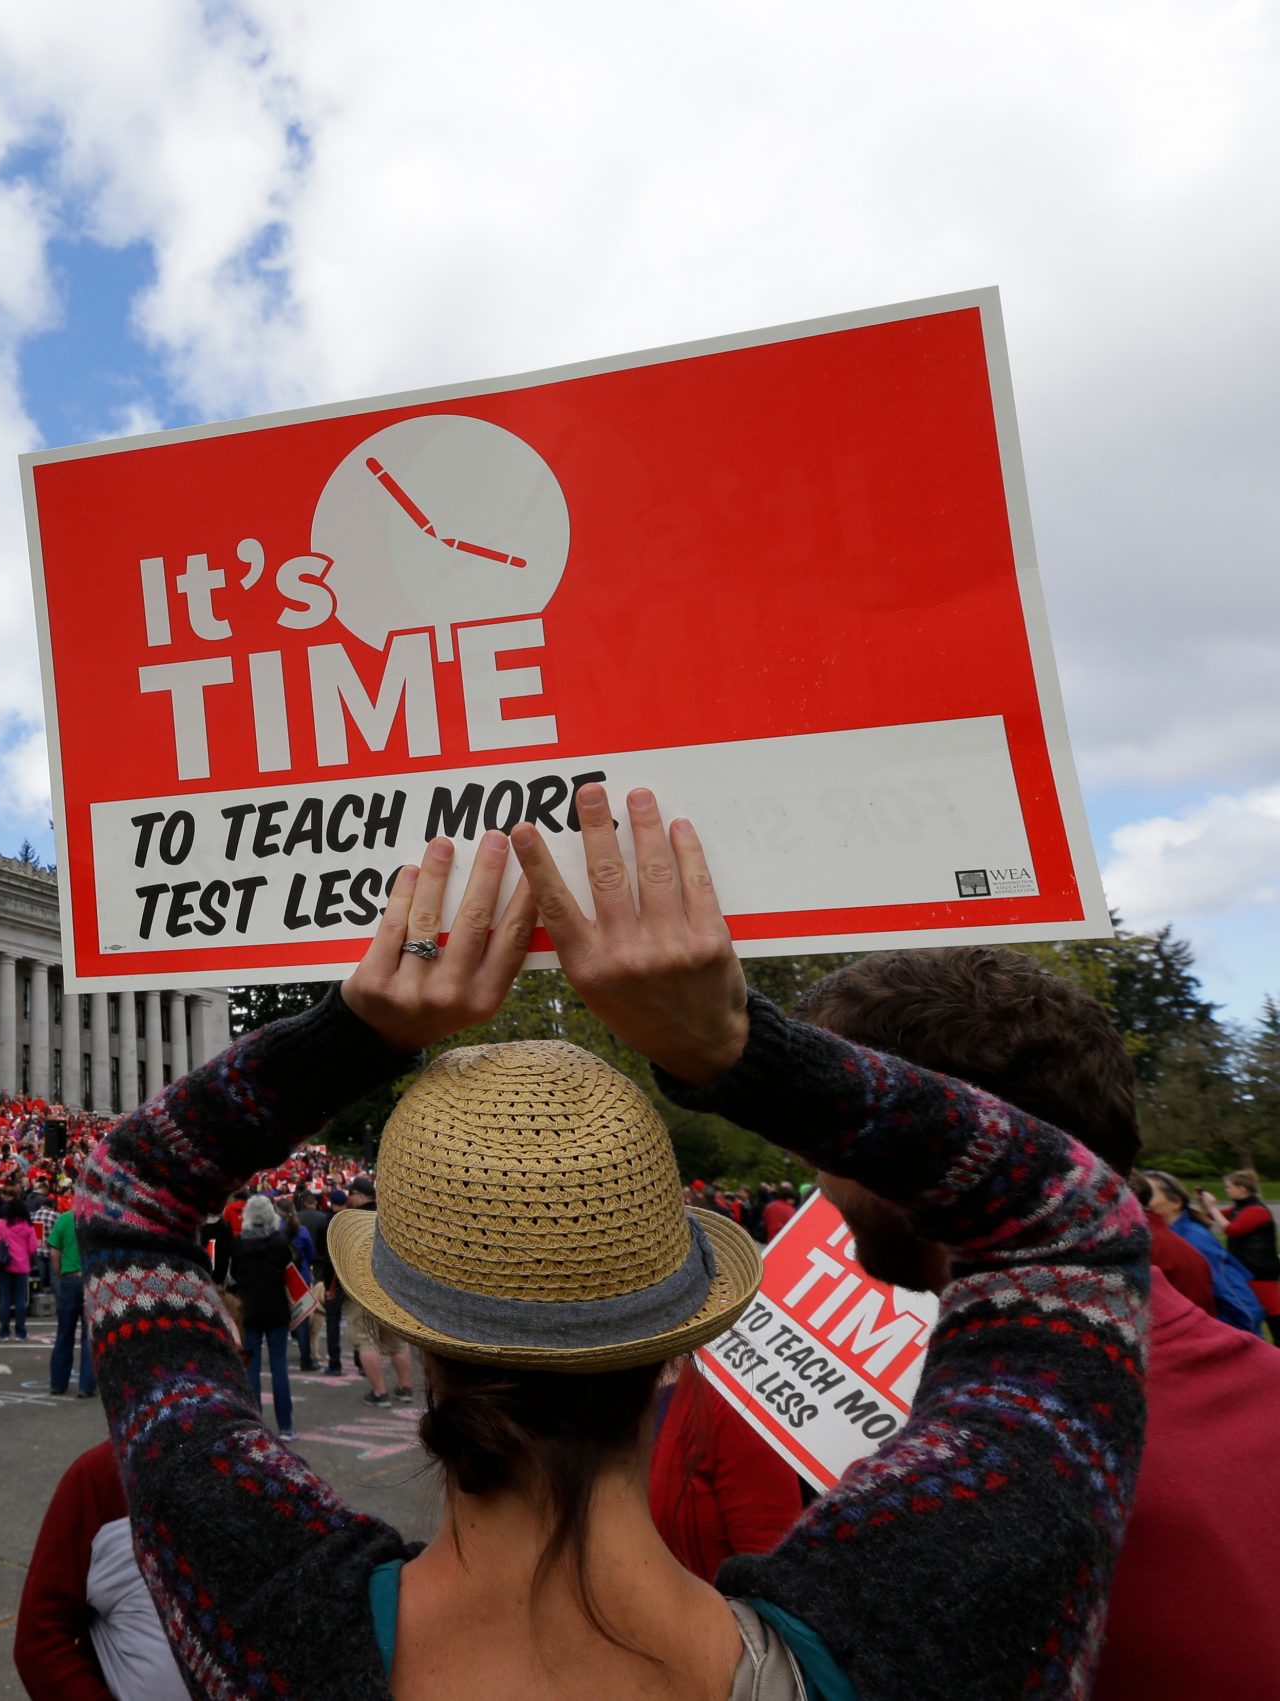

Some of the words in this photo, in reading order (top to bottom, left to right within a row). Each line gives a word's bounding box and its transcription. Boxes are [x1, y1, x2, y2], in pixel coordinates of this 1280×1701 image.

[139, 537, 334, 648] It's
[137, 618, 560, 781] TIME
[131, 810, 196, 868] TO
[221, 790, 407, 861] TEACH
[989, 867, 1032, 881] WEA
[135, 875, 269, 940] TEST
[283, 865, 405, 930] LES
[716, 1329, 769, 1377] TEST
[756, 1371, 819, 1429] LESS
[740, 1301, 774, 1333] TO
[766, 1323, 846, 1396] TEACH
[833, 1389, 899, 1448] MO
